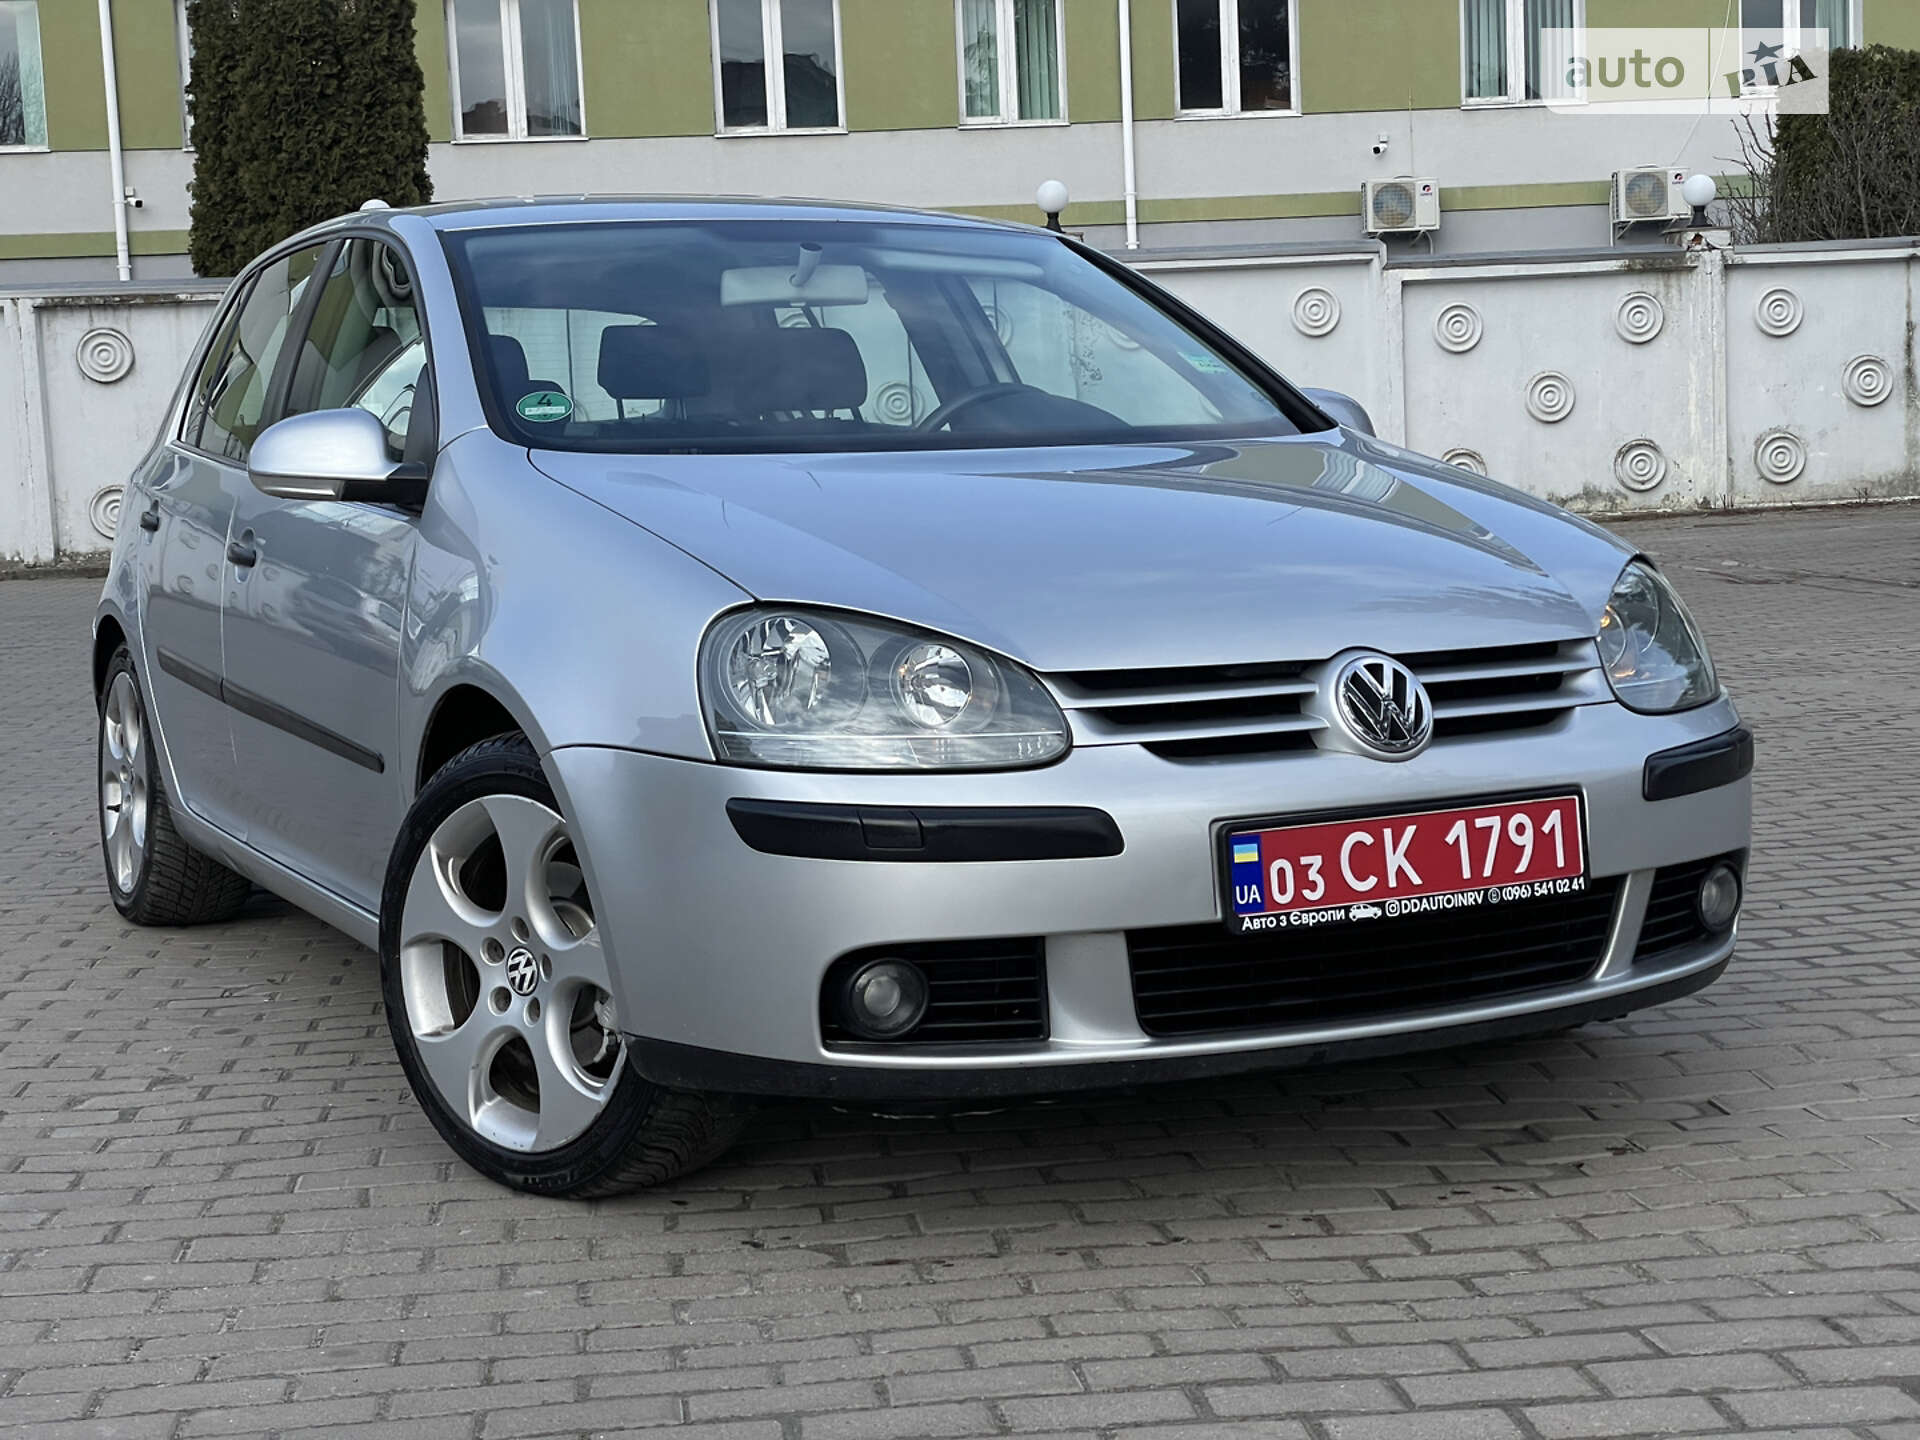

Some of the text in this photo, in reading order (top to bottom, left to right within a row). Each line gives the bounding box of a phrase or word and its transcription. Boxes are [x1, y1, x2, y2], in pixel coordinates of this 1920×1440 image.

[537, 393, 552, 407] 4
[1269, 809, 1565, 904] 03 CK 1791
[1235, 885, 1261, 905] UA
[1401, 877, 1585, 914] DDAUTOINRV (096) 541 02 41
[1242, 909, 1345, 931] Авто з Європи
